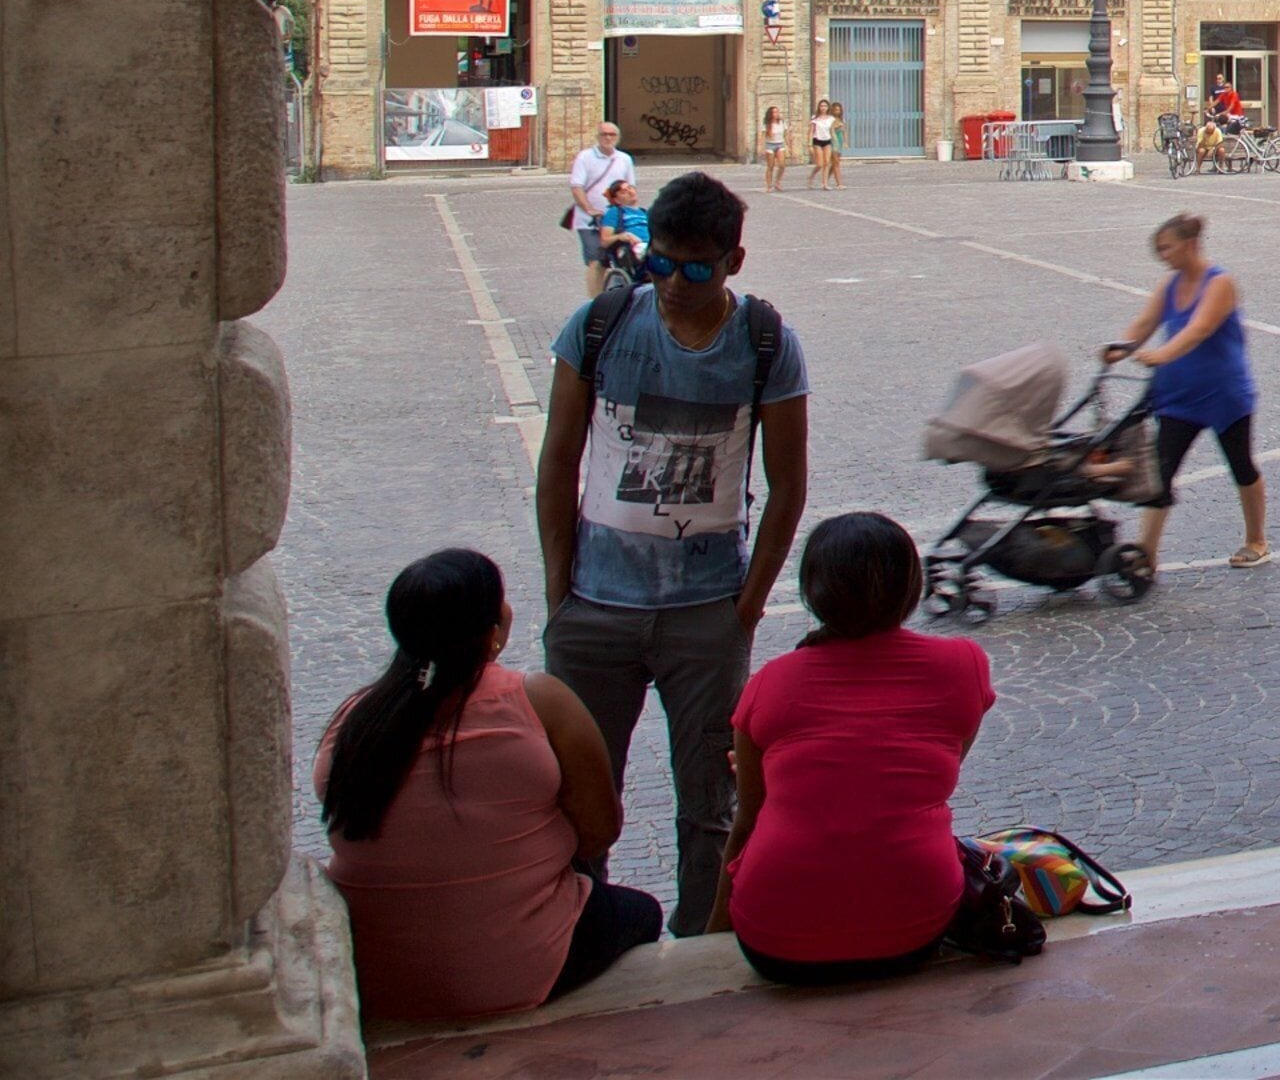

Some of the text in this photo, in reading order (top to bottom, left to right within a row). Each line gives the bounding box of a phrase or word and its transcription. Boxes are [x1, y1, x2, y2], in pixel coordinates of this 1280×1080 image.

[832, 5, 871, 16] SIENA
[1022, 7, 1059, 17] SIENA
[418, 13, 441, 24] FUGA
[442, 14, 469, 24] DALLA
